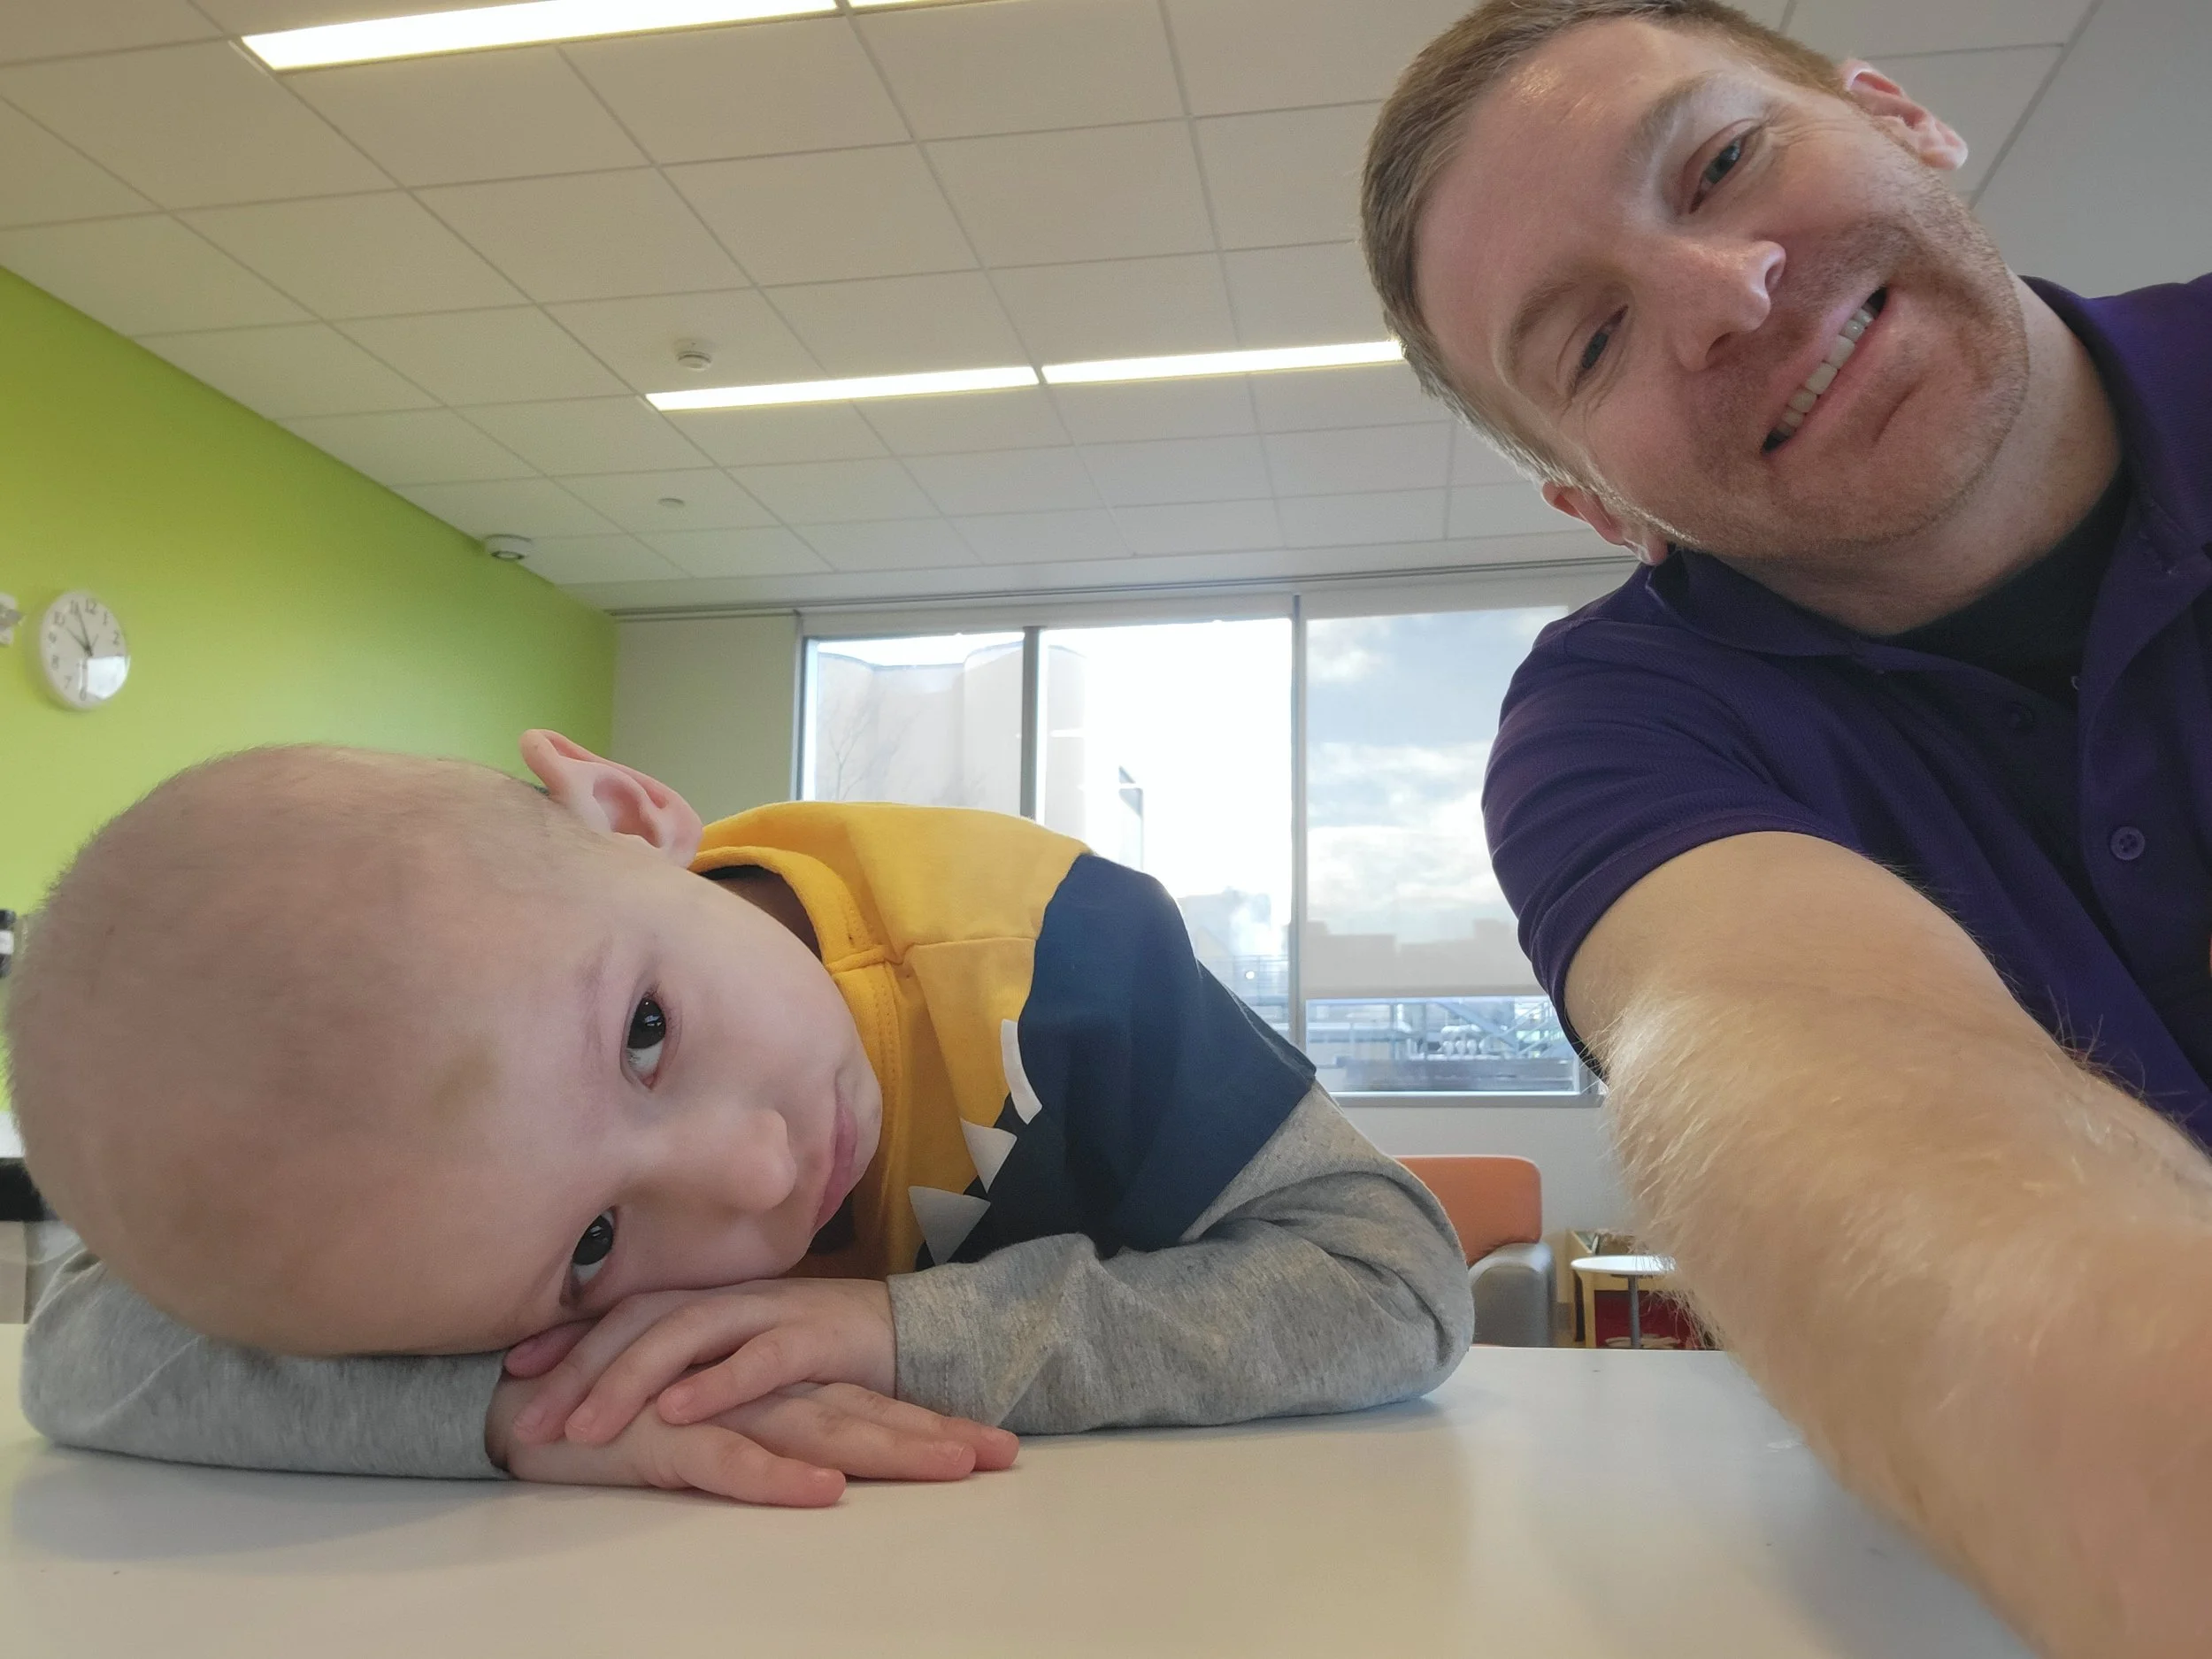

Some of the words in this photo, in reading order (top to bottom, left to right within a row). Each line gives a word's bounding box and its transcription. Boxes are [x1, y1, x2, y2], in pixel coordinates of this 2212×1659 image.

[85, 598, 97, 615] 12
[102, 611, 108, 626] 1
[113, 630, 119, 646] 2
[65, 676, 73, 688] 7
